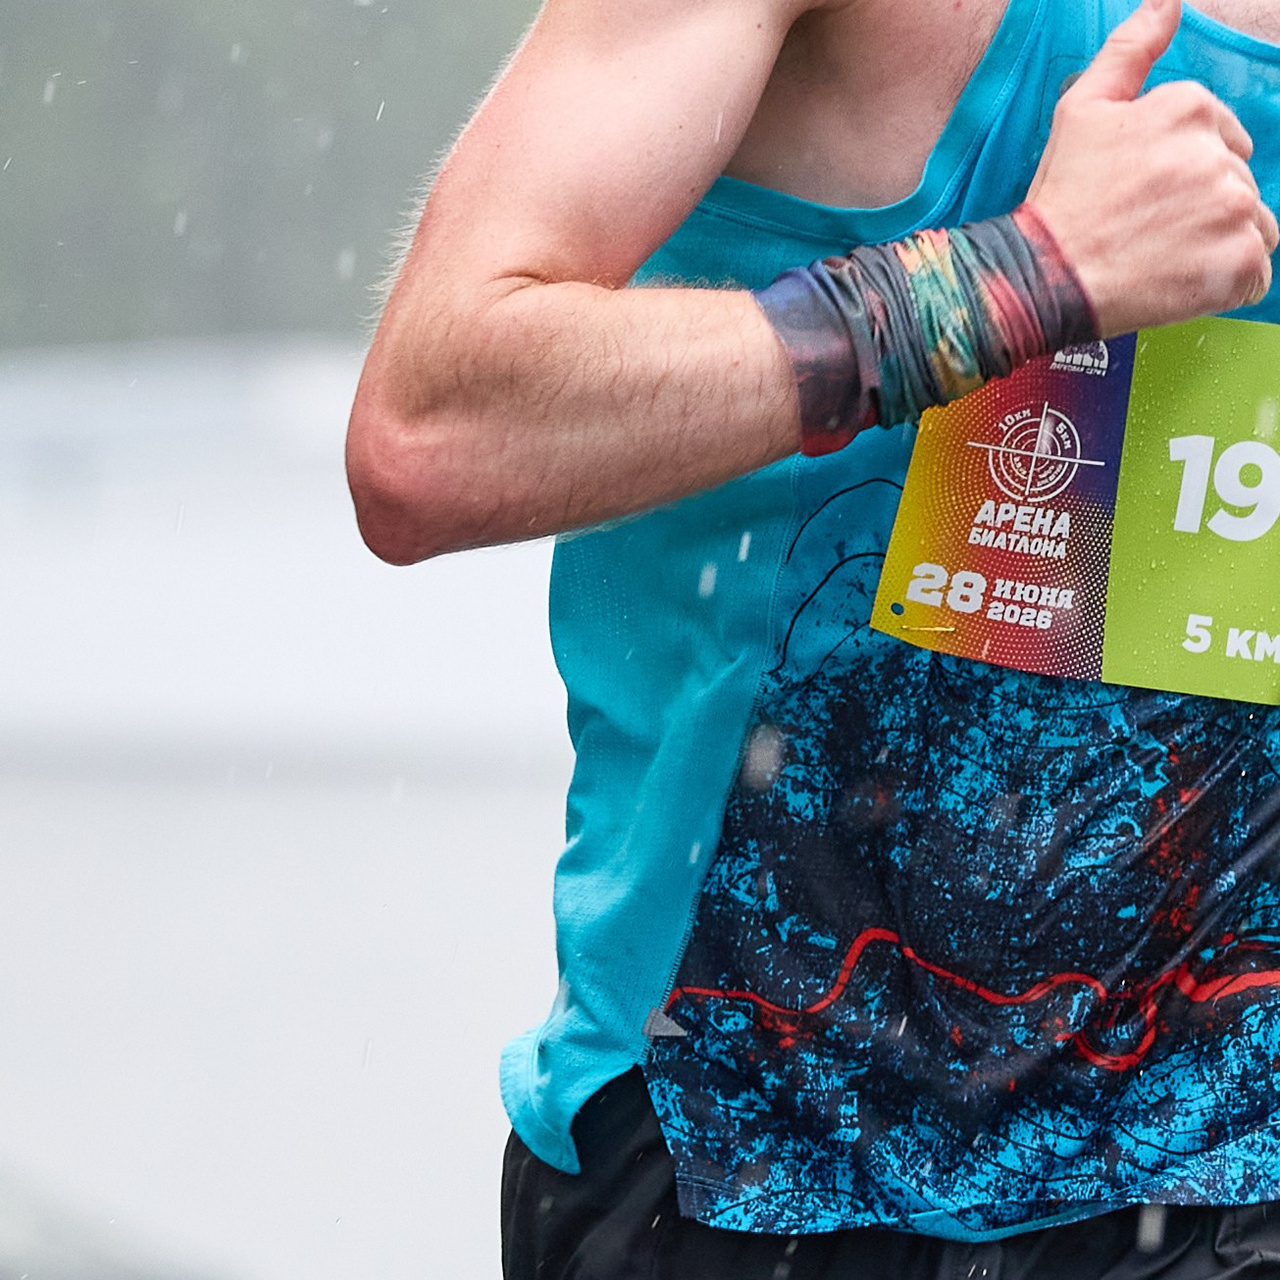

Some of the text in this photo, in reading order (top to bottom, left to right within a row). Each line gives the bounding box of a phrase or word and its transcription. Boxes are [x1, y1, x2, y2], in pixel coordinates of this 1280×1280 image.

[973, 499, 1071, 539] АРЕНА
[967, 526, 1067, 560] БИАТЛОНА
[906, 562, 988, 614] 28
[985, 600, 1054, 630] 2026
[1181, 613, 1214, 654] 5
